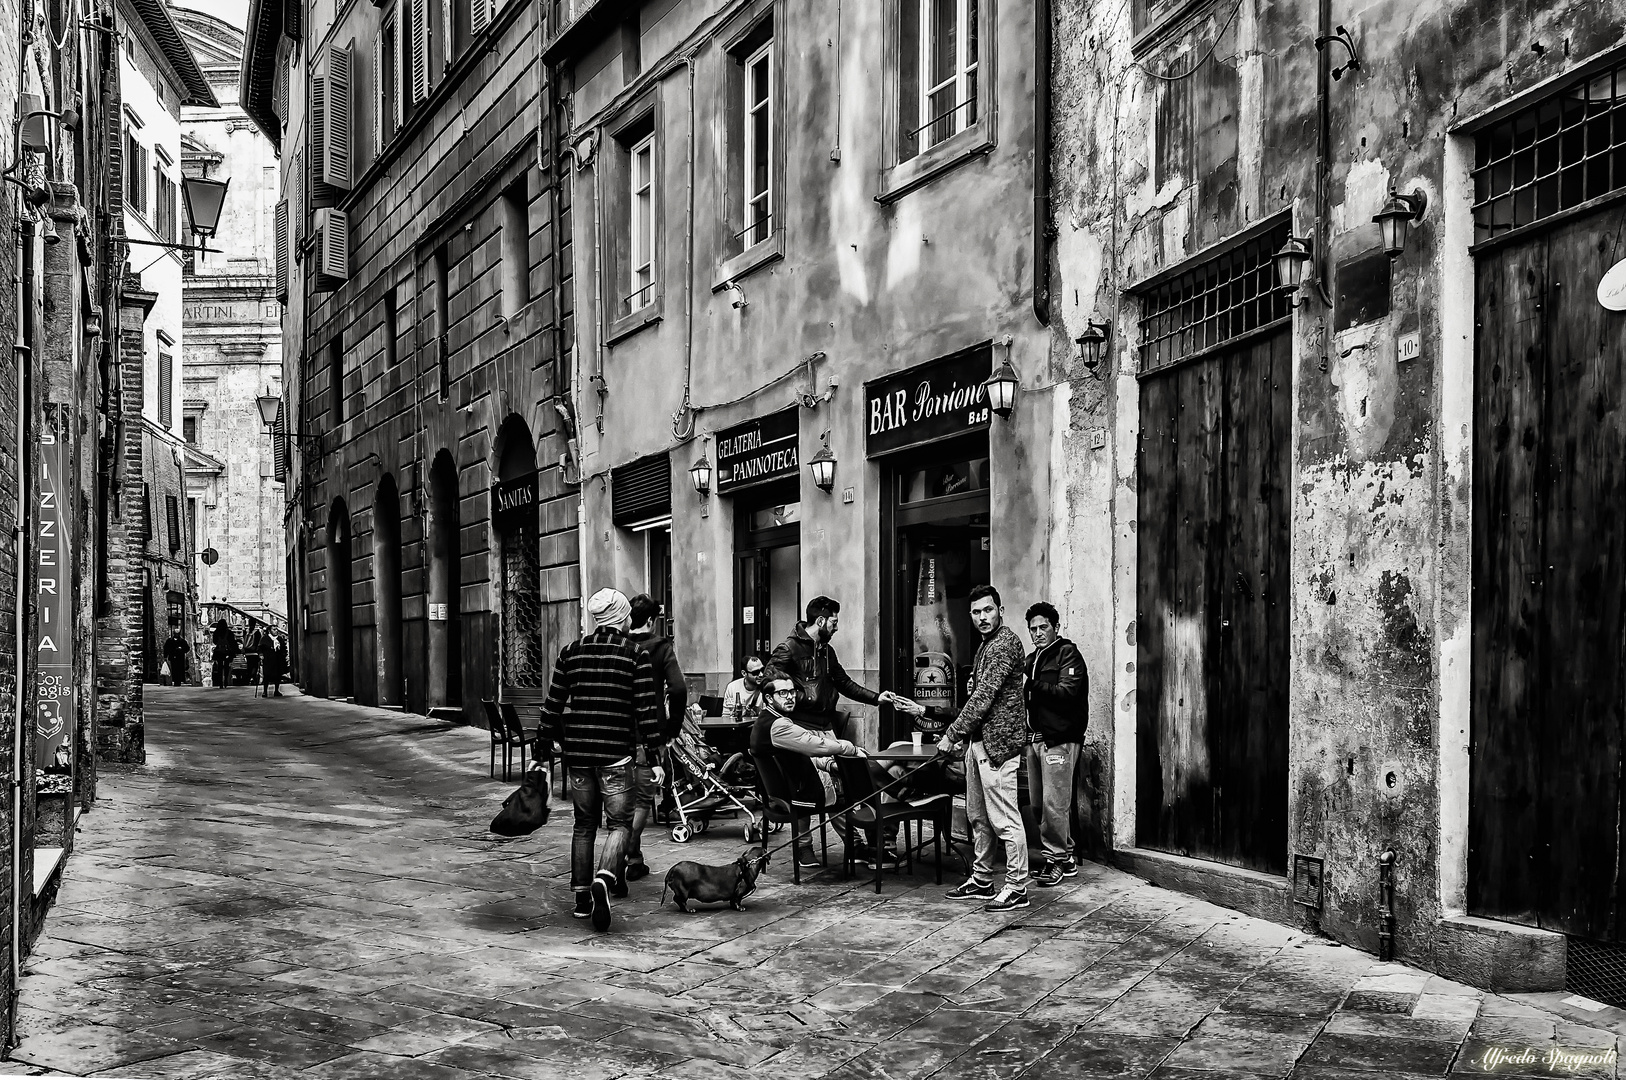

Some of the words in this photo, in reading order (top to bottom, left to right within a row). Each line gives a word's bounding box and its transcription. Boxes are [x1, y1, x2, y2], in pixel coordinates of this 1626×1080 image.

[182, 306, 232, 318] ARTINI
[1403, 339, 1413, 356] 10
[870, 389, 907, 435] BAR
[912, 380, 987, 421] Porrione
[968, 407, 989, 425] B&B
[718, 429, 762, 460] GELATERIA
[732, 447, 798, 482] PANINOTECA
[498, 485, 532, 512] SANITAS
[39, 684, 71, 699] agis
